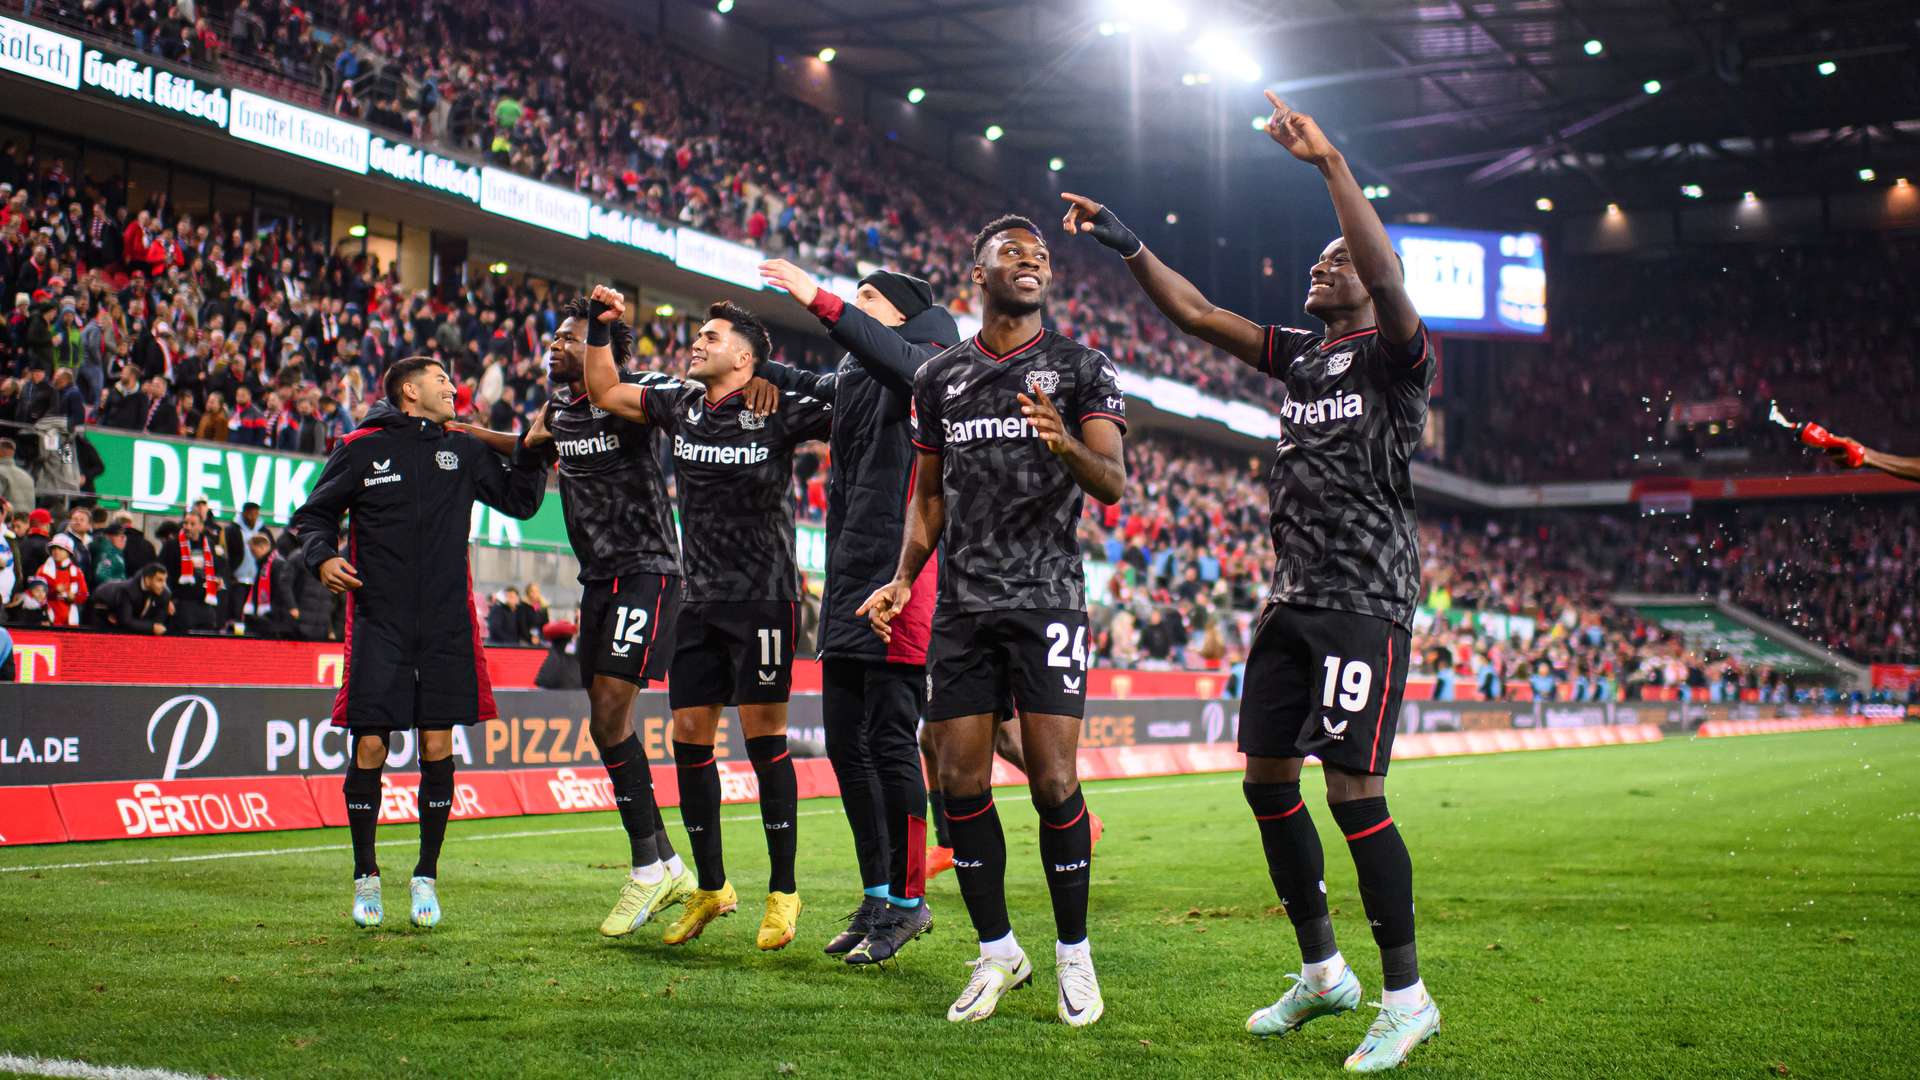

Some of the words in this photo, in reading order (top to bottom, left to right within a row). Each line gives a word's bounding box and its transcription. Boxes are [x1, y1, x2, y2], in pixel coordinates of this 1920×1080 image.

[83, 50, 153, 103] Gaffel
[154, 71, 229, 129] Kölsch
[554, 431, 620, 457] armenia
[673, 434, 769, 465] Barmenia
[940, 415, 1040, 443] Barmen
[131, 439, 316, 525] DEVK
[364, 472, 402, 487] Barmenia
[613, 606, 648, 645] 12
[757, 628, 782, 666] 11
[1046, 622, 1086, 672] 24
[1322, 655, 1373, 712] 19
[266, 718, 472, 771] PICOA
[116, 783, 276, 836] DERTOUR
